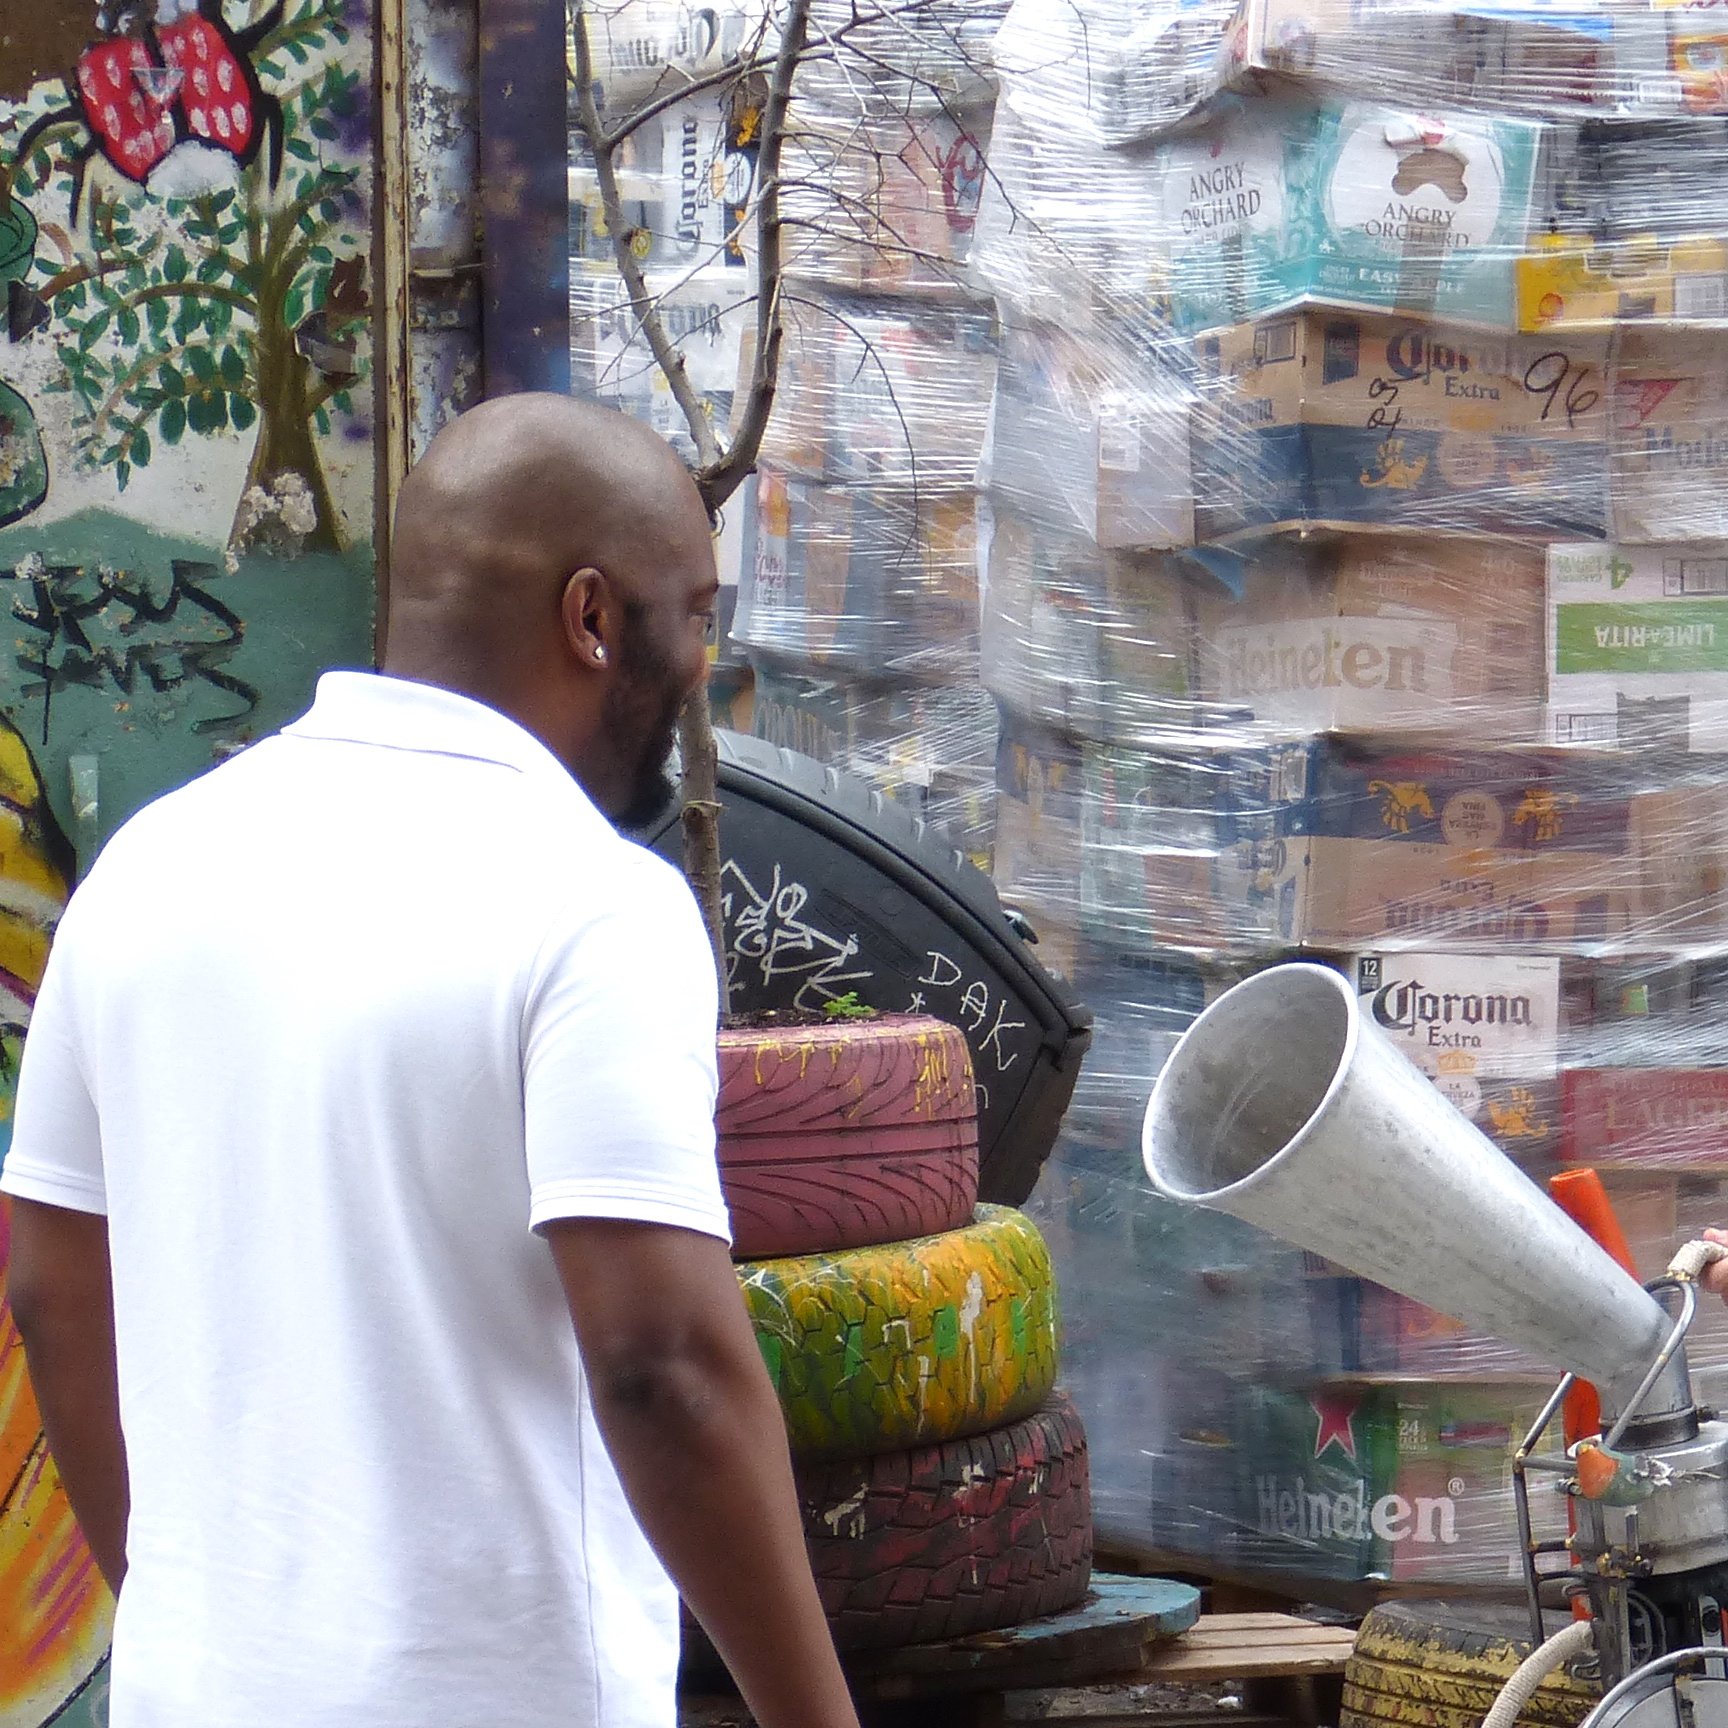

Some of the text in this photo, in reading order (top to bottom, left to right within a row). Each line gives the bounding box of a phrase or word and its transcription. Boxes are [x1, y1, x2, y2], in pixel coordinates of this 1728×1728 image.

[1189, 161, 1245, 202] ANGRY
[1181, 189, 1261, 235] ORCHARD
[1383, 202, 1457, 227] ANGRY
[1444, 376, 1500, 401] Extra
[1524, 352, 1599, 429] 96
[1608, 556, 1634, 590] 4
[1362, 959, 1378, 977] 12
[1372, 979, 1533, 1037] Corona
[1427, 1025, 1482, 1048] Extra
[1256, 1476, 1459, 1544] Heineken
